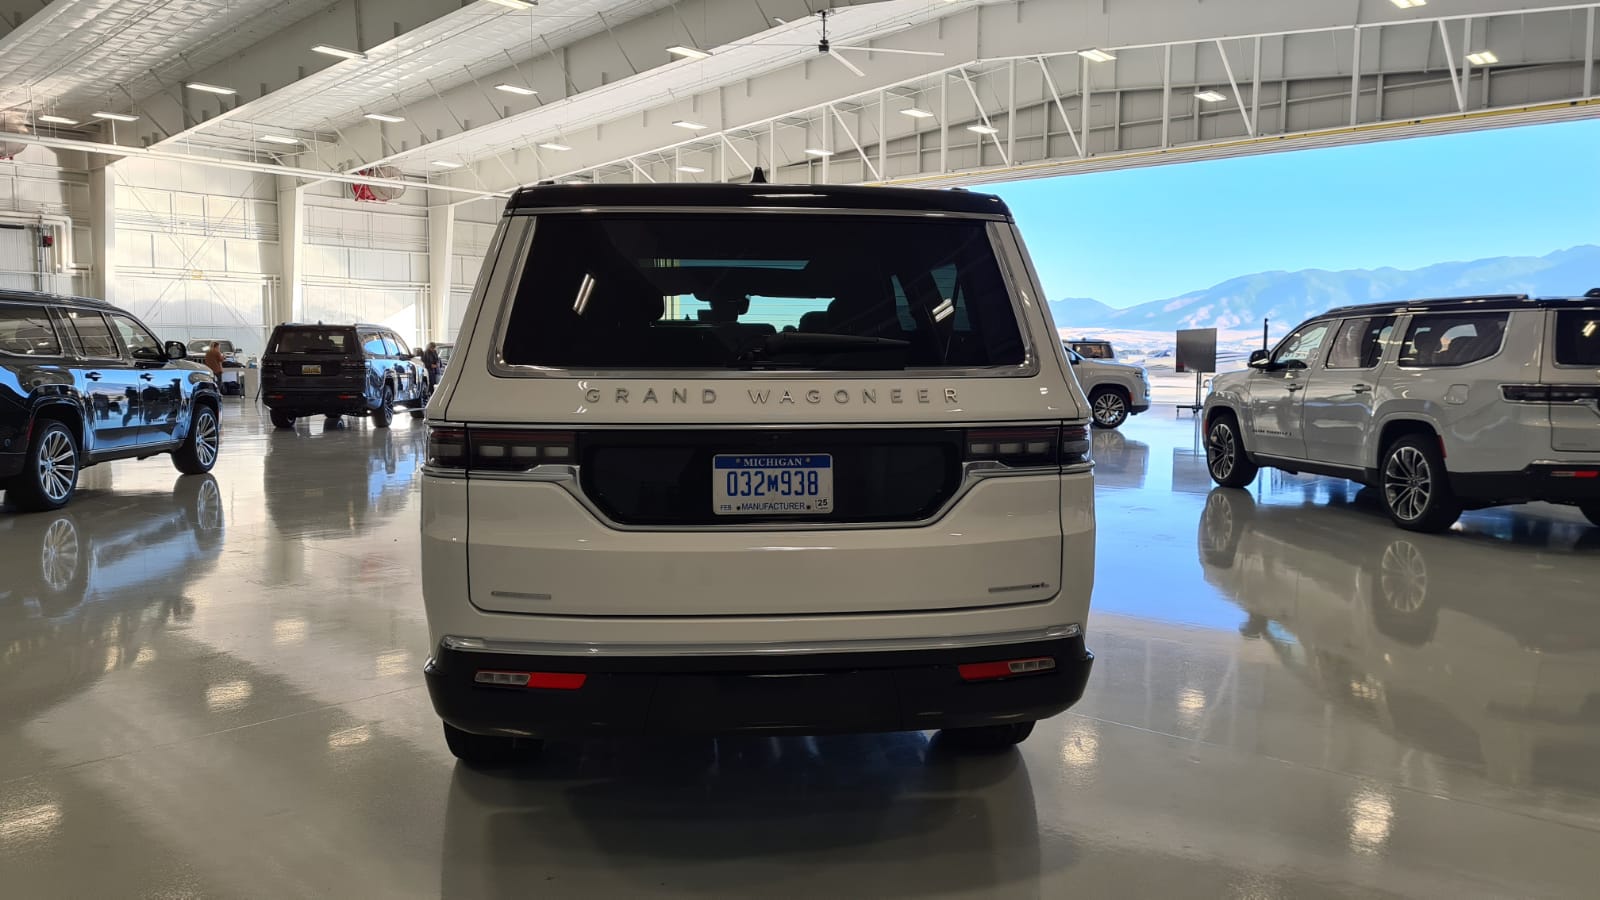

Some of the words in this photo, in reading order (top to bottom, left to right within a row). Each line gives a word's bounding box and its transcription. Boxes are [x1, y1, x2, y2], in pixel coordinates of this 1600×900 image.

[584, 388, 717, 404] GRAND
[748, 388, 959, 404] WAGONEER
[743, 457, 802, 467] MICHIGAN
[727, 470, 818, 496] 032M938
[741, 502, 805, 511] MANUFACTURER
